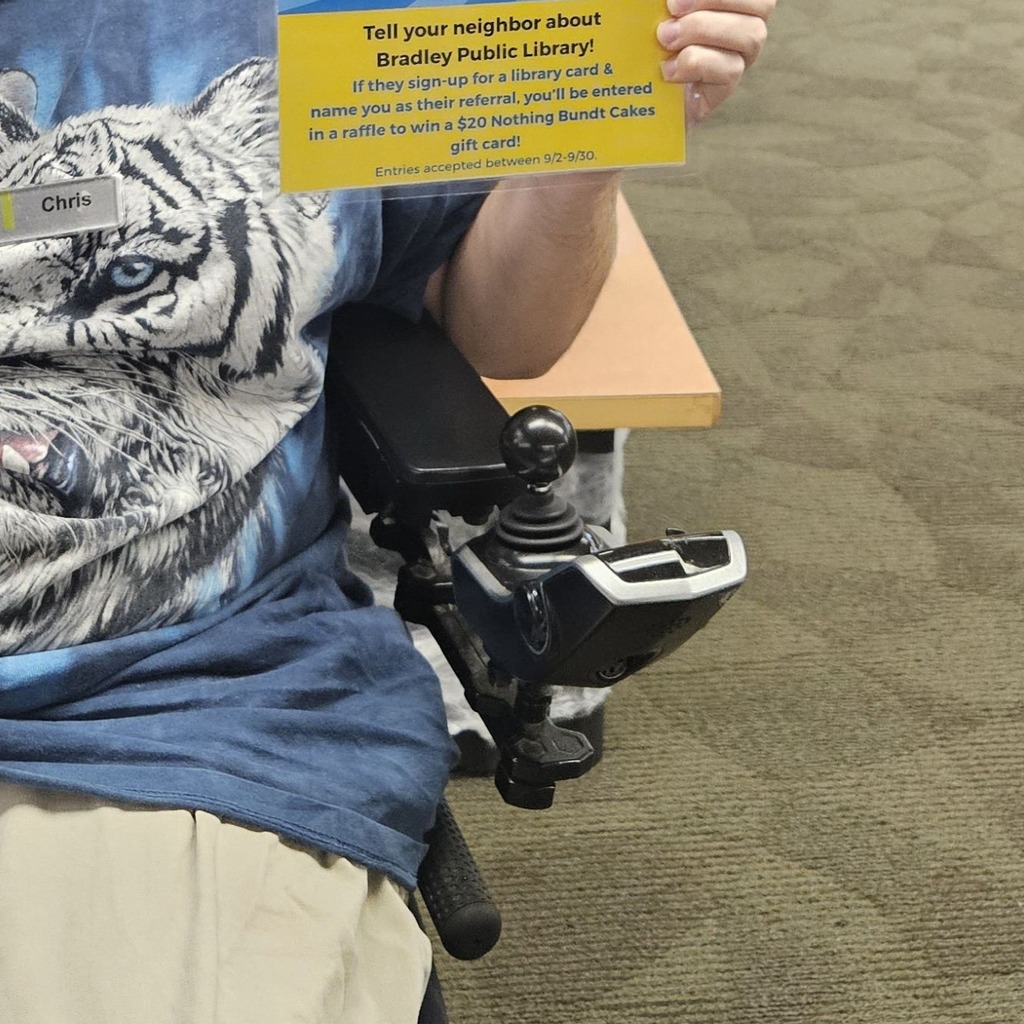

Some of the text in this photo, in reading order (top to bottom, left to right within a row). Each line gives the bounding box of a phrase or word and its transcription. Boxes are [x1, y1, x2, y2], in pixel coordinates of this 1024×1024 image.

[363, 12, 601, 42] Tell your neighbor about
[377, 38, 594, 67] Bradley Public Library!
[352, 62, 613, 93] If they sign-up for a library card &
[310, 82, 653, 118] name you as their referral, you'll be entered
[309, 104, 656, 141] in a raffle to win a $20 Nothing Bundt Cakes
[450, 136, 521, 156] gift card!
[375, 150, 597, 177] Entries accepted between 9/2-9/30.
[41, 192, 93, 213] Chris
